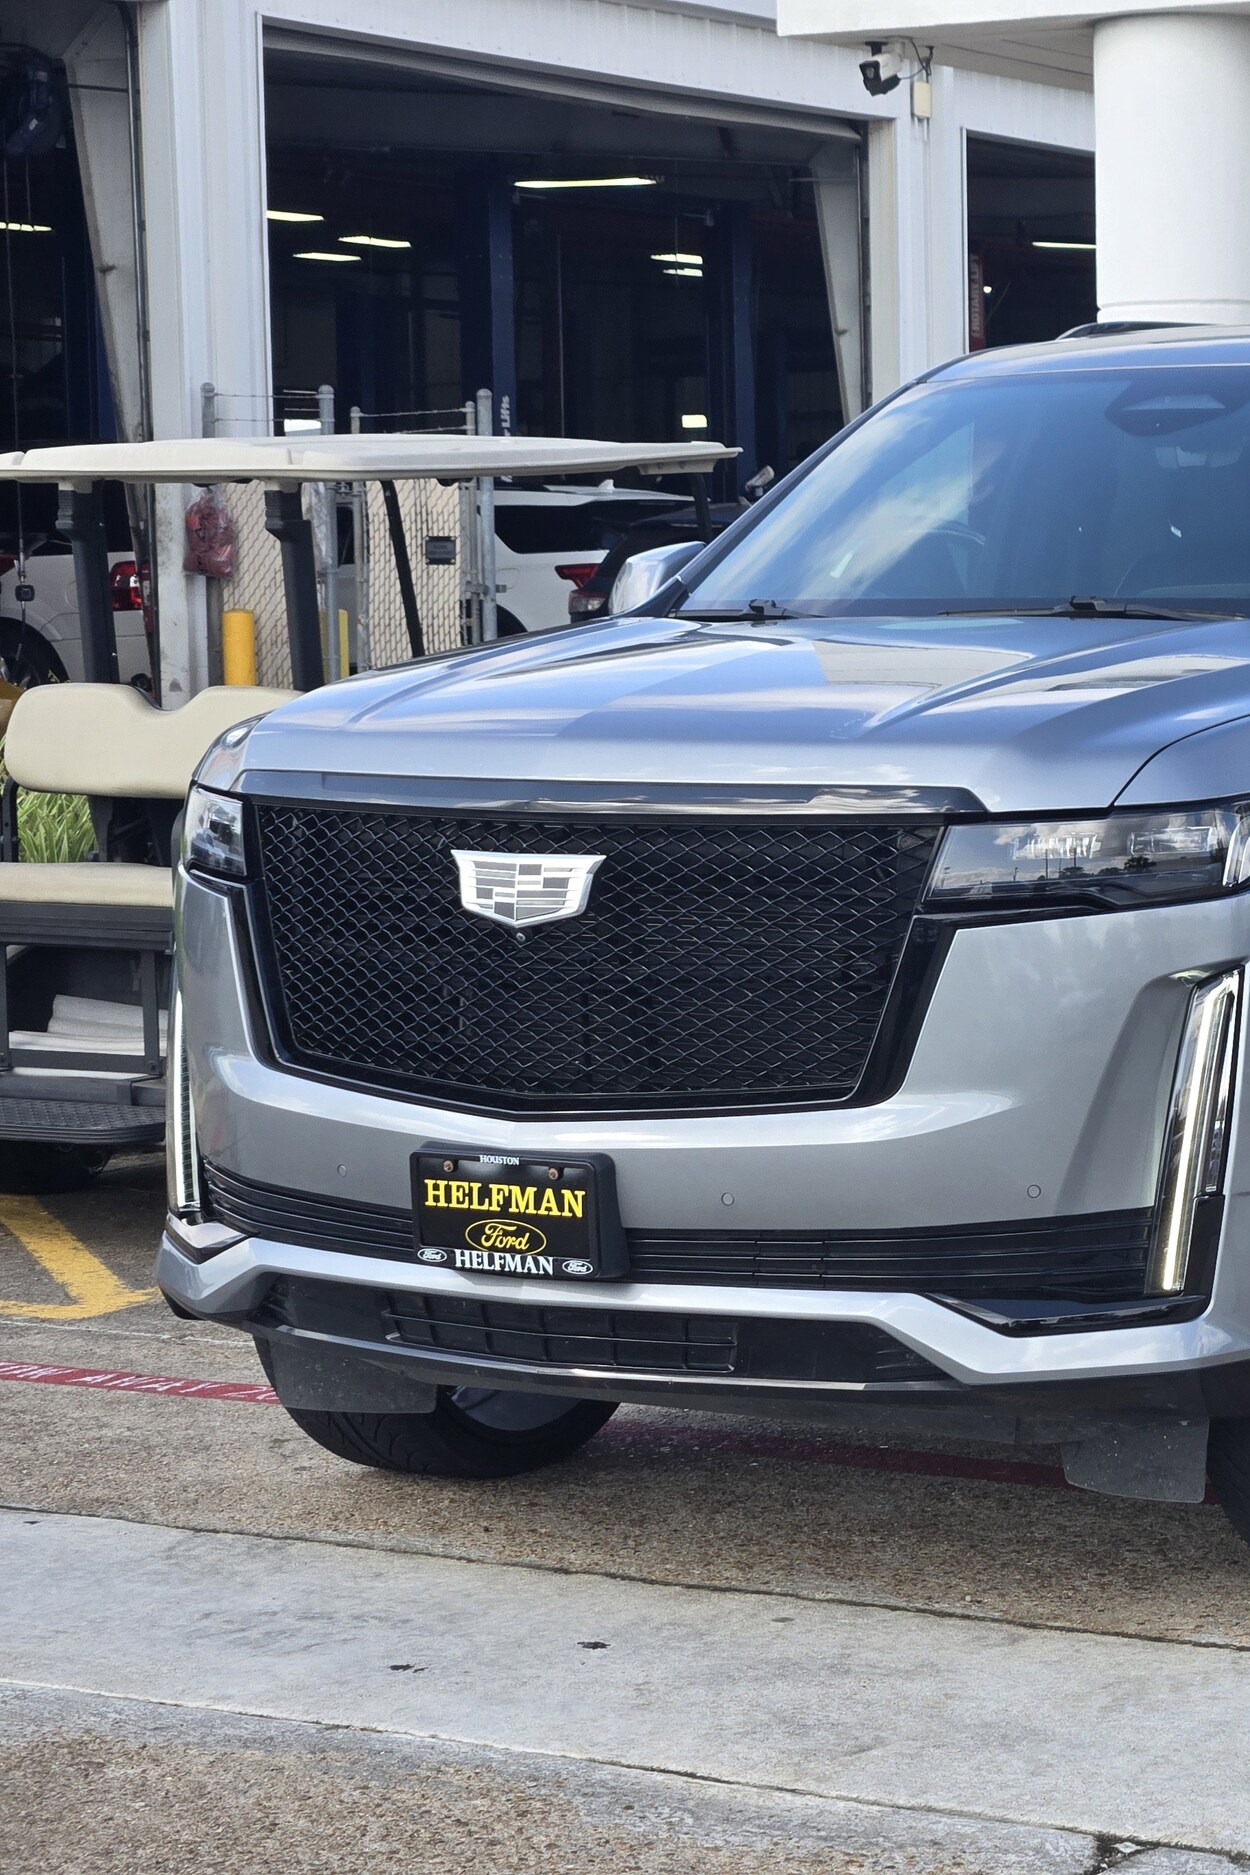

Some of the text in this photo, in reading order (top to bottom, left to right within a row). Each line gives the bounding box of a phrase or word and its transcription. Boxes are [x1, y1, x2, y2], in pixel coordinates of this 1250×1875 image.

[480, 1154, 520, 1166] HOUSTON
[424, 1179, 586, 1218] HELFMAN
[480, 1223, 530, 1251] Ford
[454, 1249, 554, 1276] HELFMAN
[567, 1262, 588, 1275] Ford
